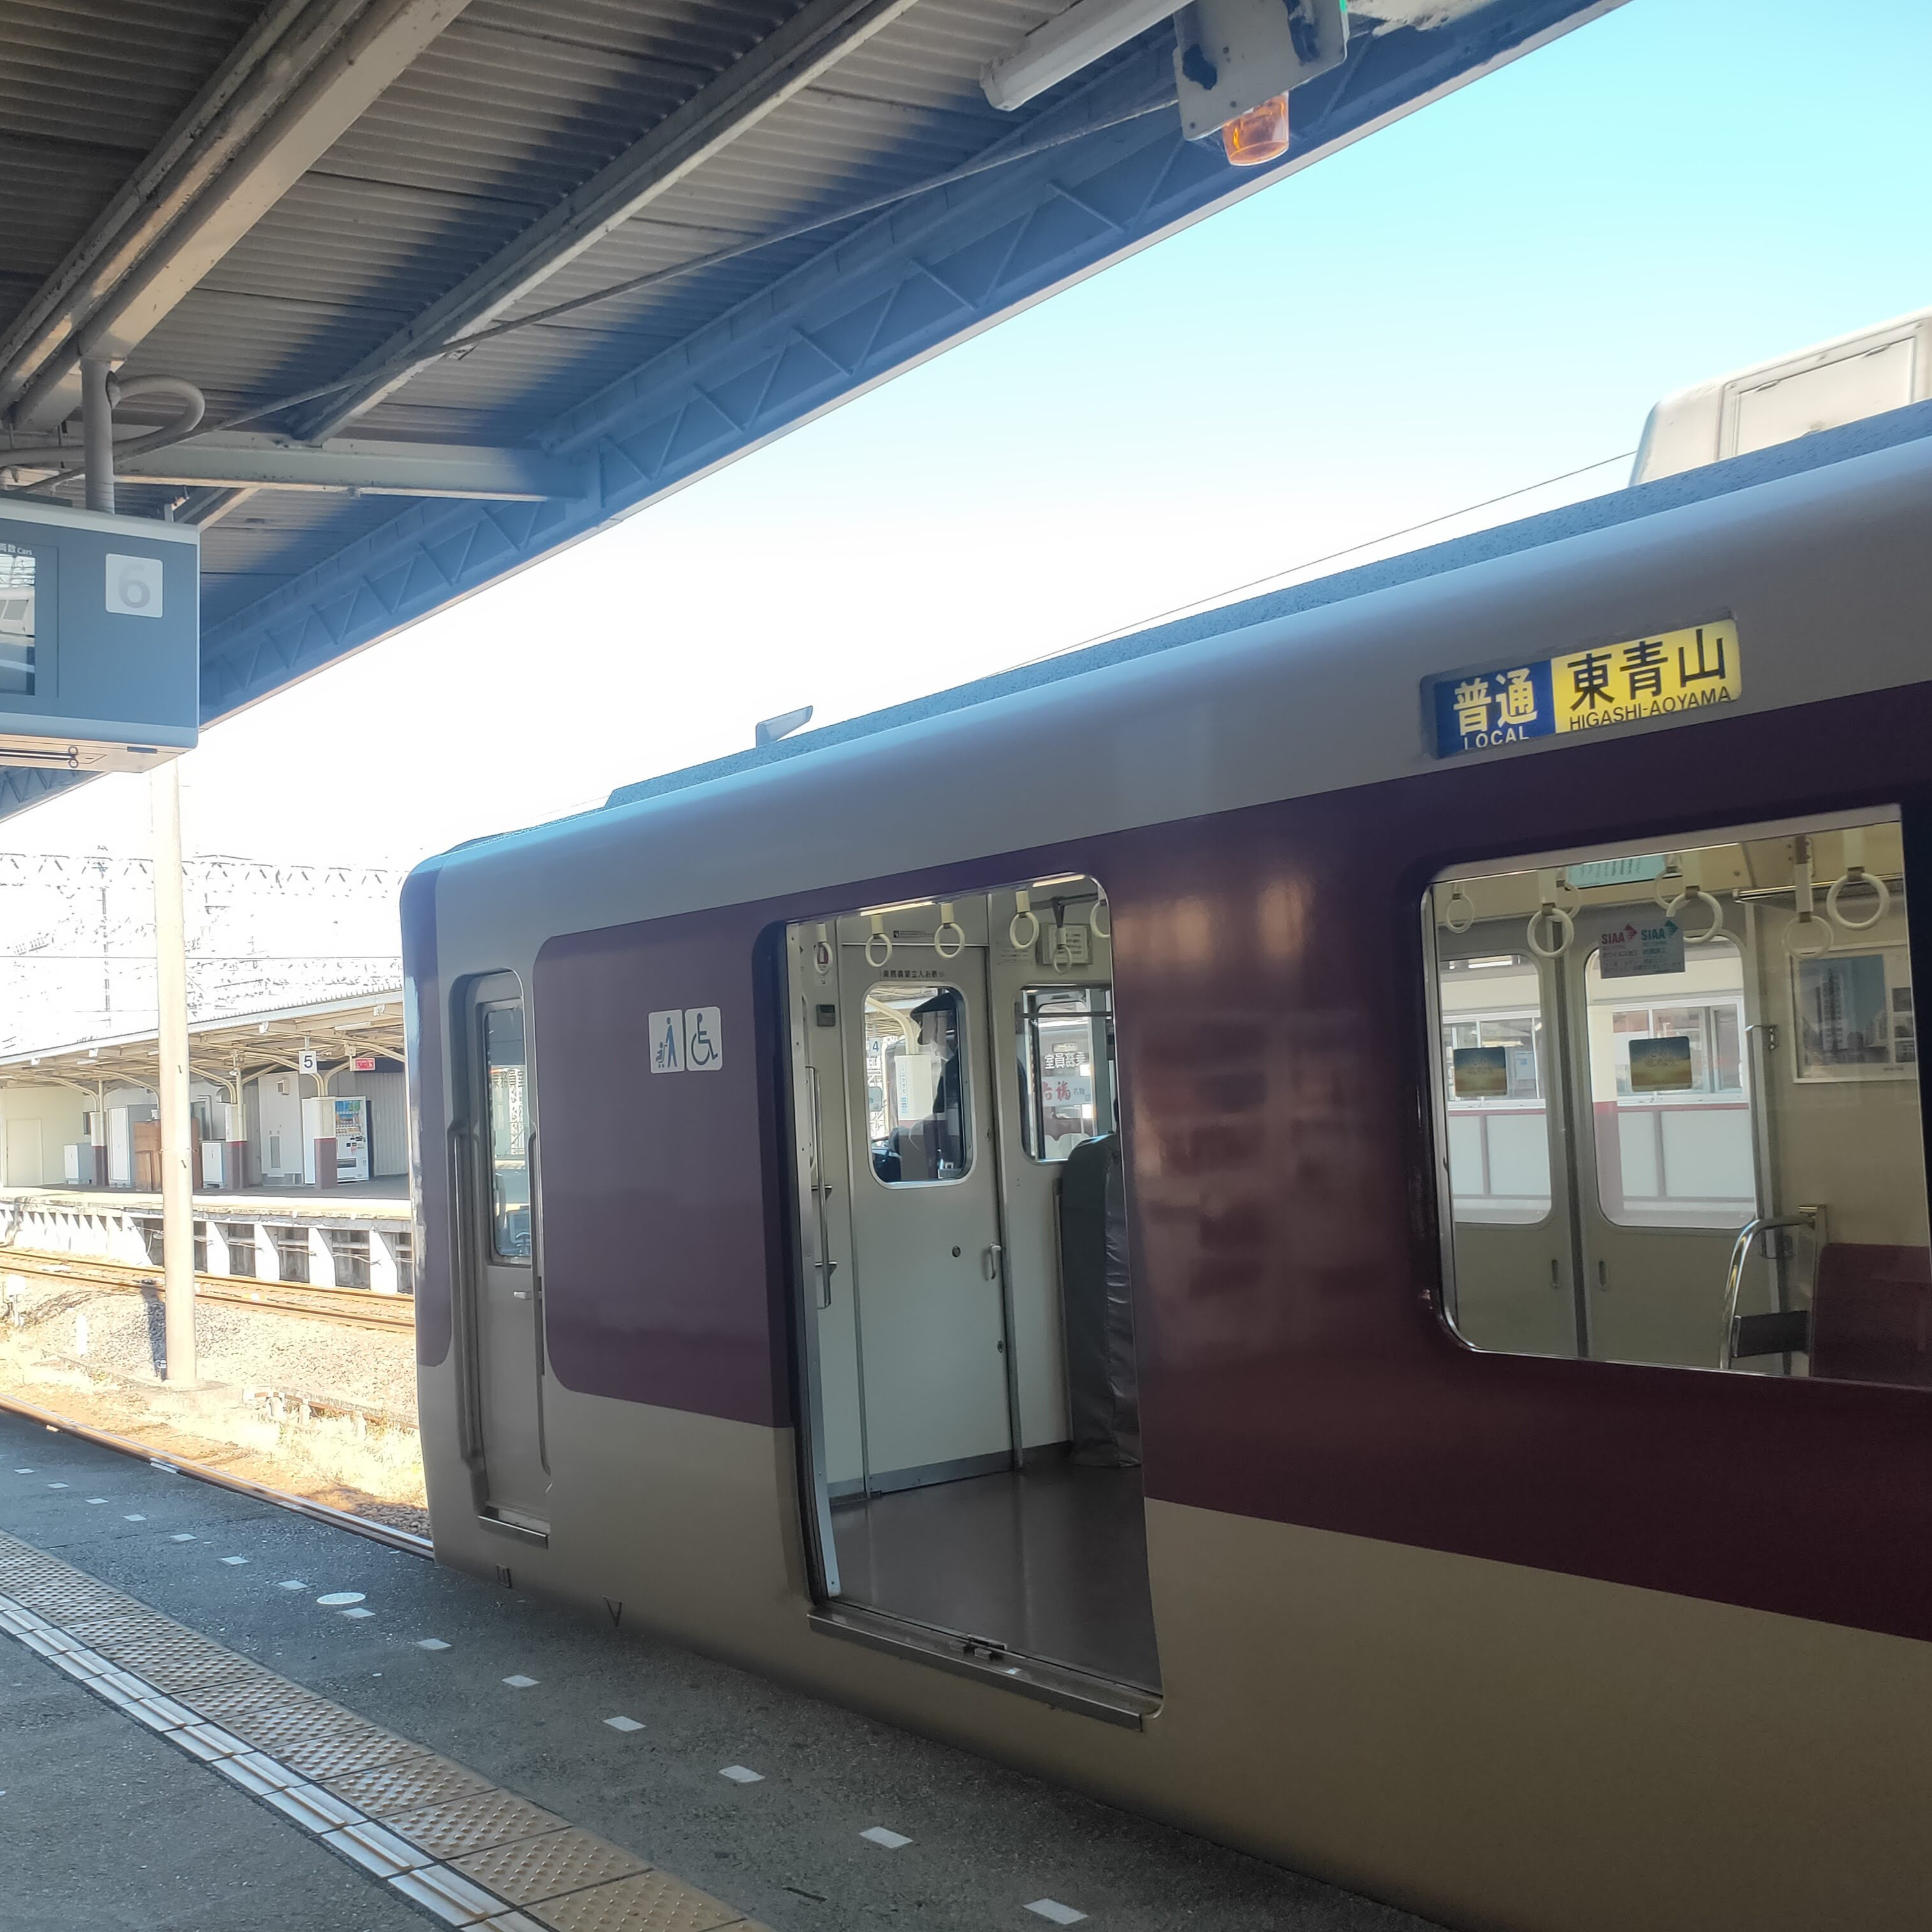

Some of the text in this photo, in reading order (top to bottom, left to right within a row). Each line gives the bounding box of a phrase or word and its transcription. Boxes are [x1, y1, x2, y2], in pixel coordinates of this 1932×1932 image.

[118, 562, 150, 609] 6
[1454, 629, 1726, 736] 普通 東青山
[1570, 686, 1731, 730] HIGASHI-AOYAMA
[1464, 726, 1530, 750] LOCAL
[1602, 932, 1625, 944] SIAA
[1641, 928, 1665, 940] SIAA
[873, 1041, 879, 1052] 4
[304, 1055, 313, 1068] 5
